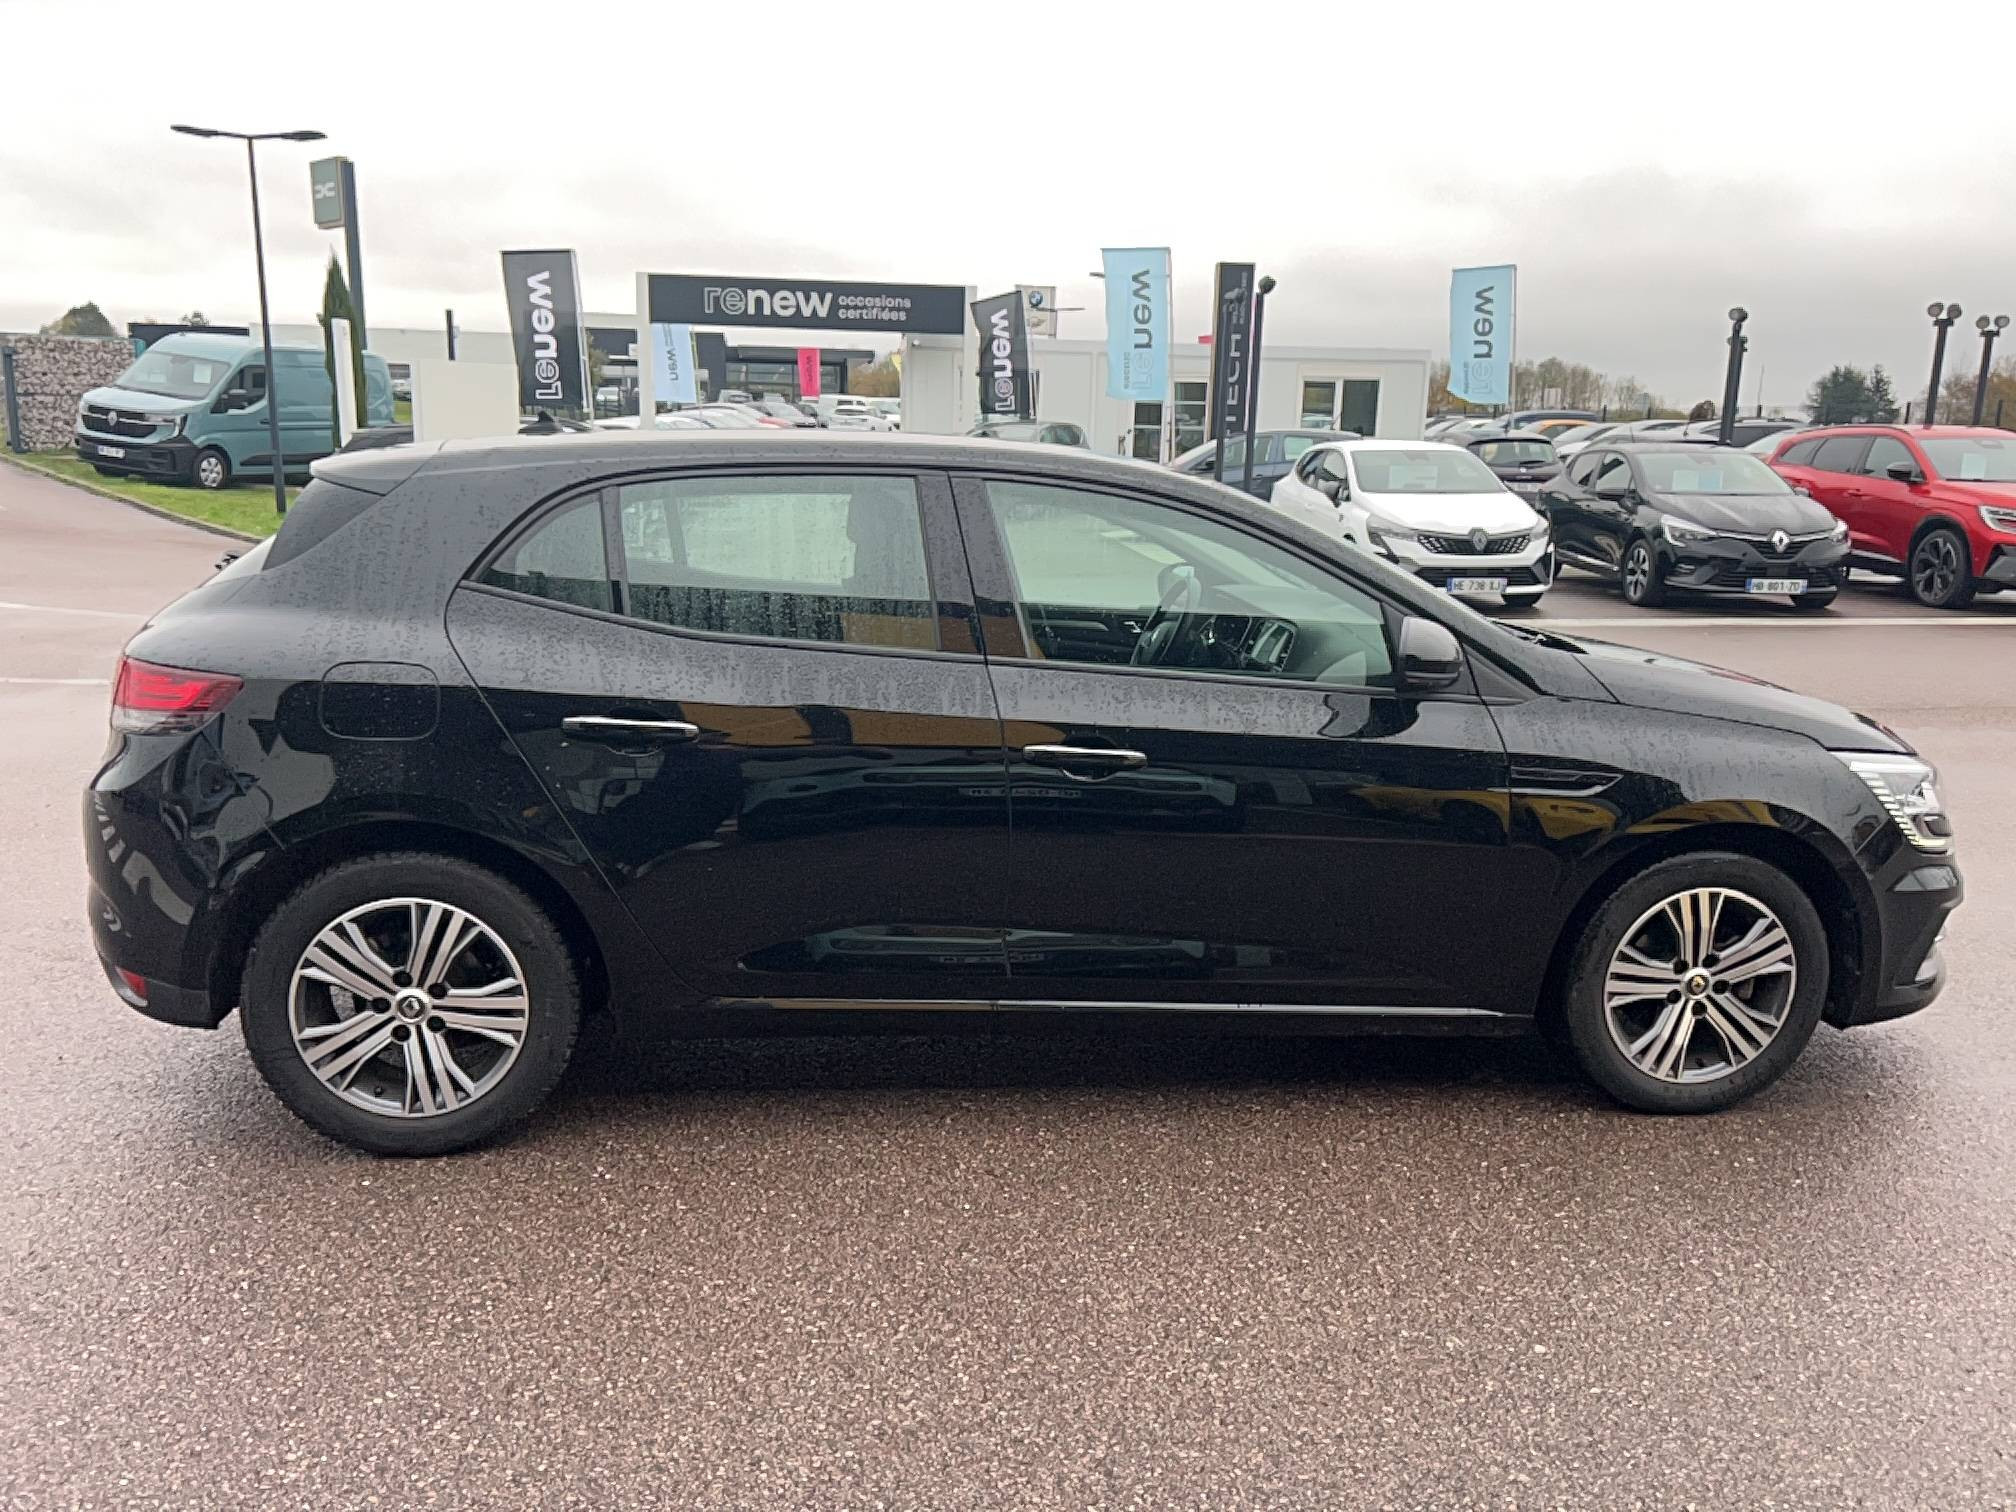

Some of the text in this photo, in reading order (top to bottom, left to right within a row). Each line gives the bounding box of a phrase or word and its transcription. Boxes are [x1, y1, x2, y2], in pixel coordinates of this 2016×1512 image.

[703, 287, 833, 318] renew
[837, 294, 912, 309] occasions
[837, 306, 908, 321] certifiées
[526, 270, 564, 400] renew
[990, 308, 1016, 412] renew
